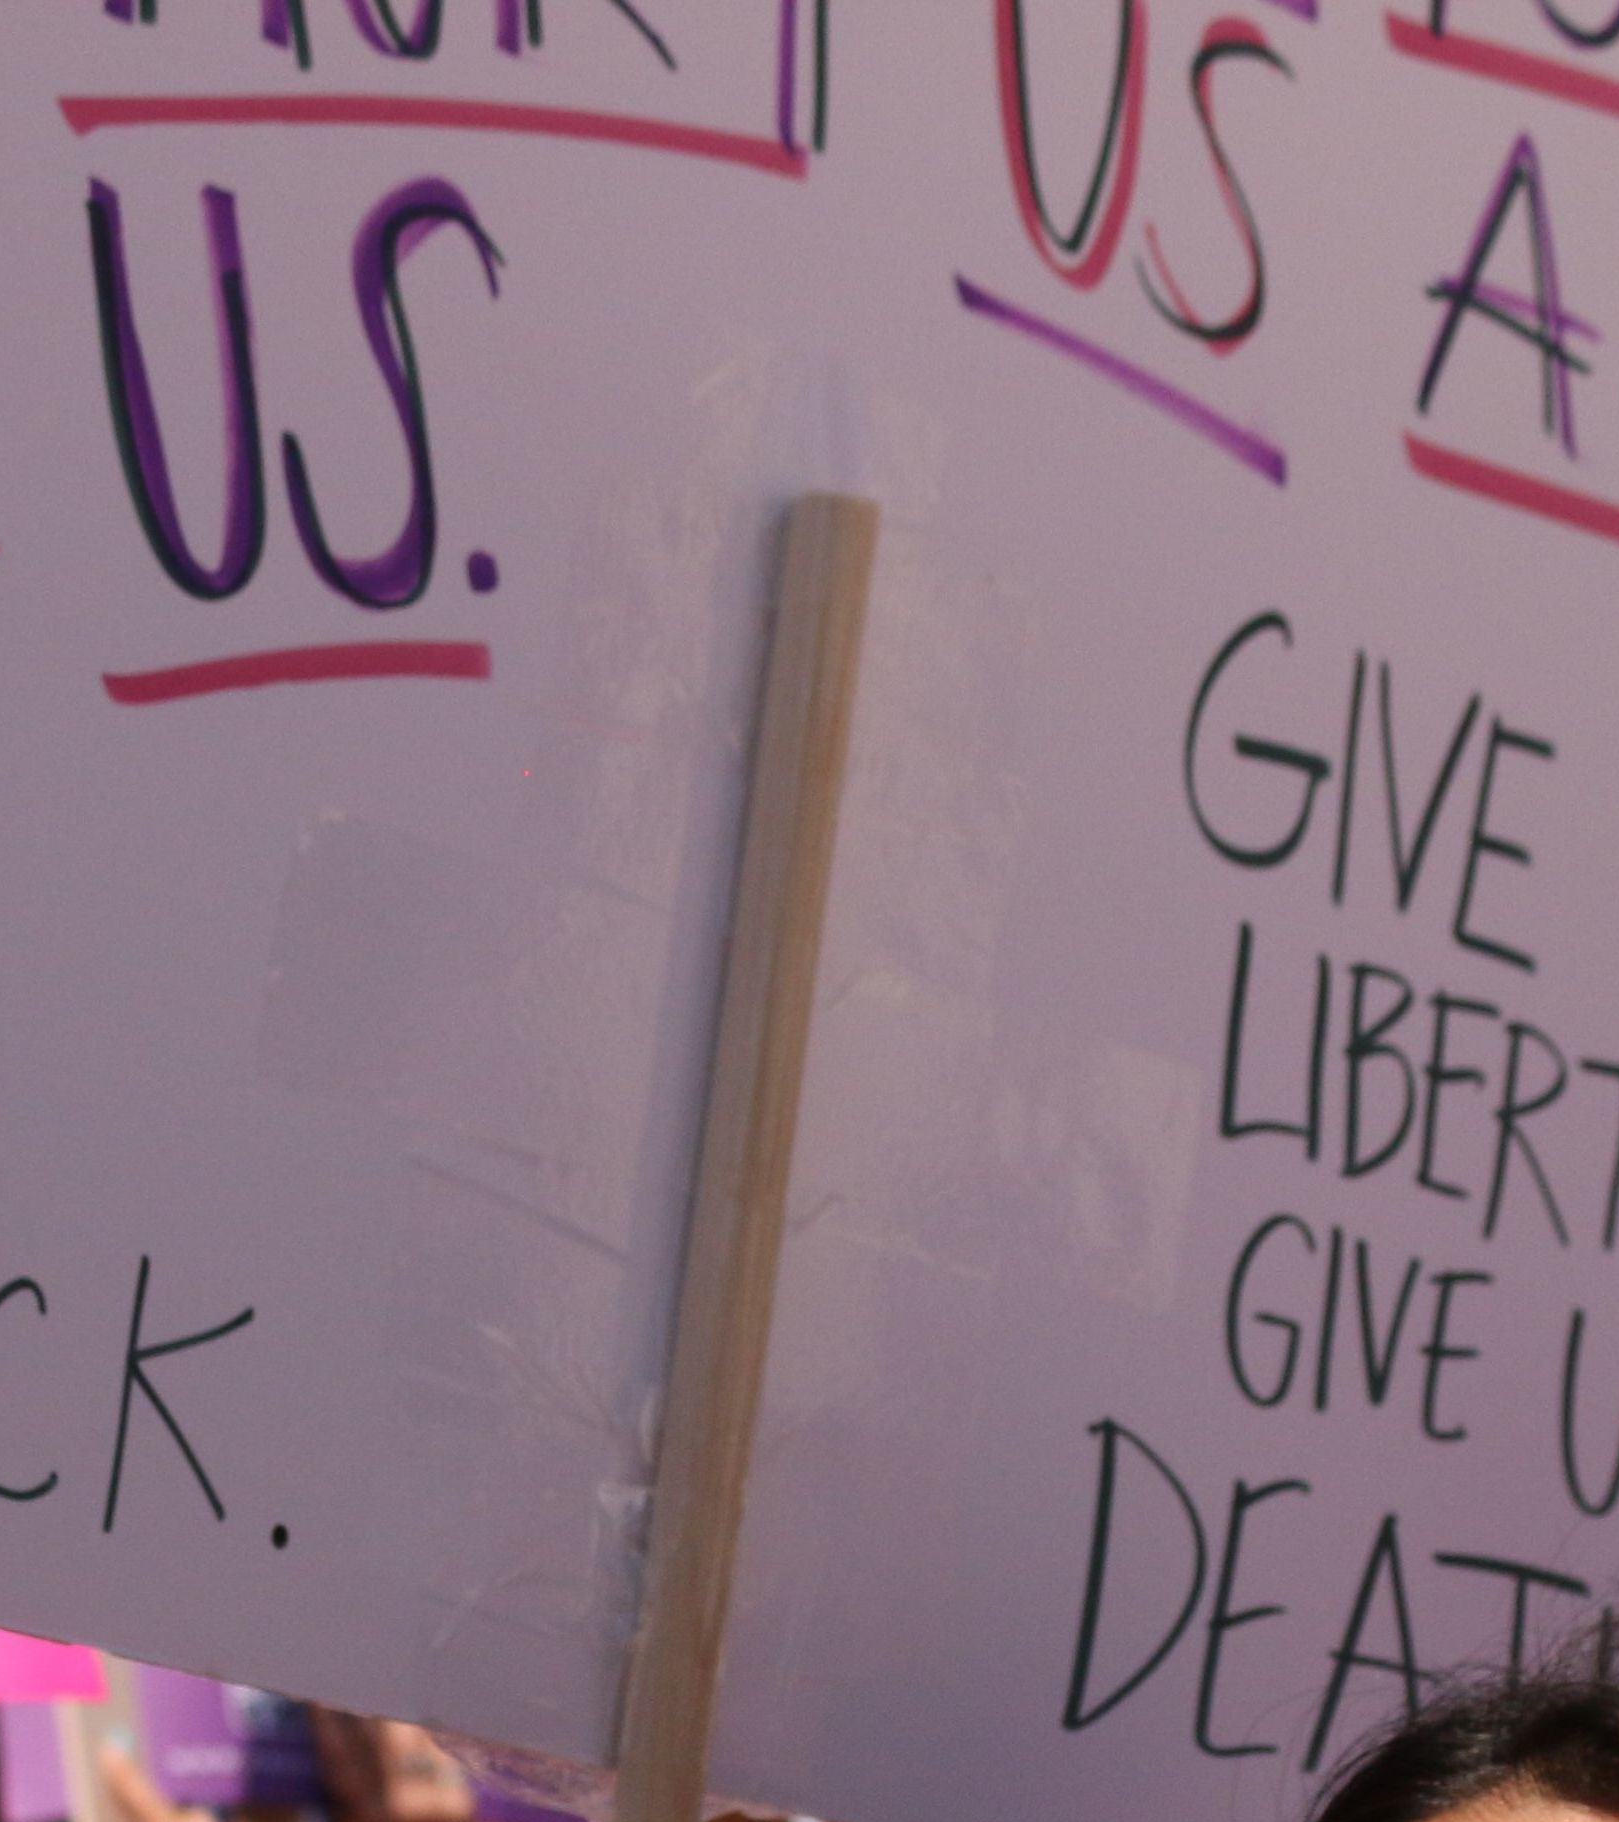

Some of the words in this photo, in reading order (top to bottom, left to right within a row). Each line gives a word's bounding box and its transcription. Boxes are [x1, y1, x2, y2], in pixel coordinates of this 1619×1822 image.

[87, 176, 505, 610] US.
[1184, 610, 1556, 975] GIVE
[1225, 1213, 1494, 1442] GIVE
[1062, 1416, 1616, 1773] DEAT
